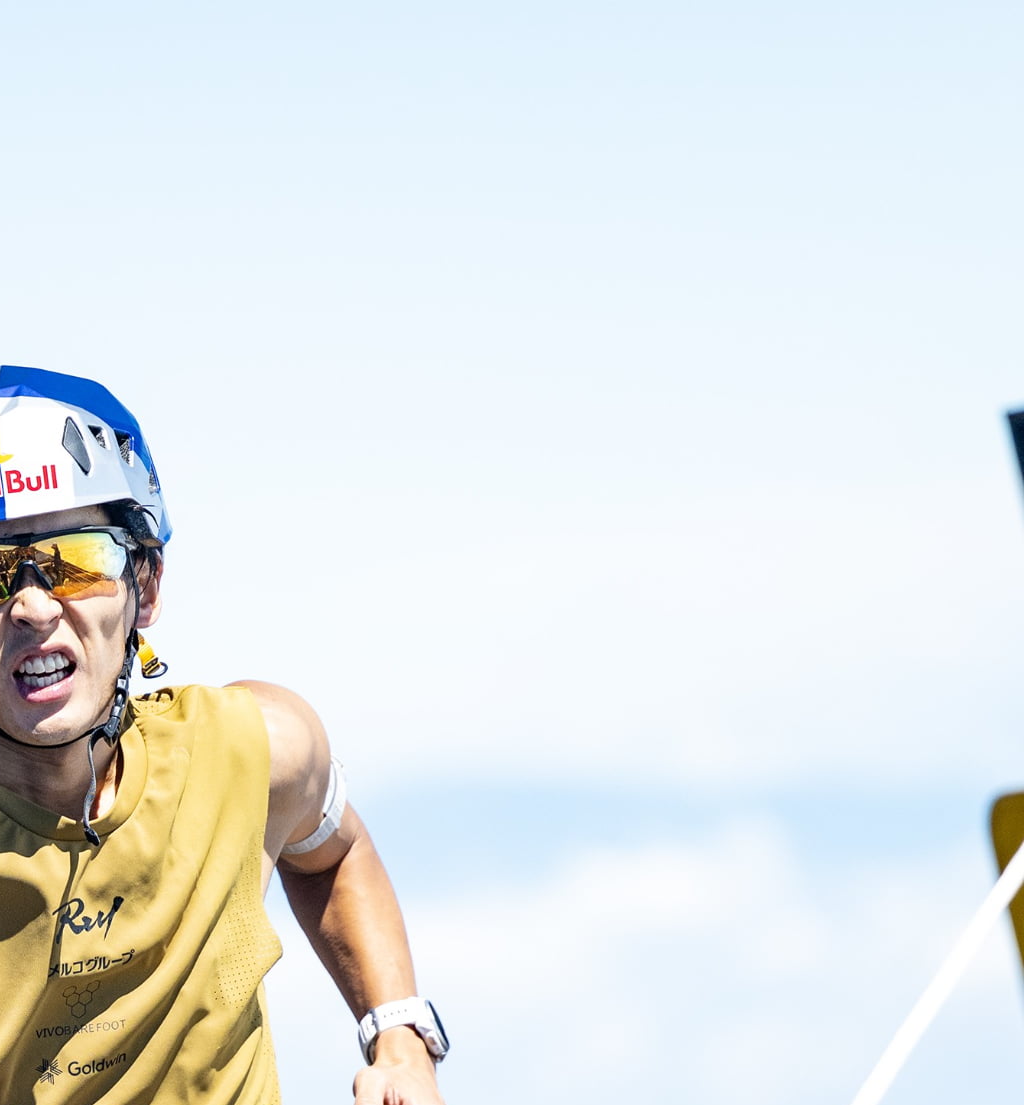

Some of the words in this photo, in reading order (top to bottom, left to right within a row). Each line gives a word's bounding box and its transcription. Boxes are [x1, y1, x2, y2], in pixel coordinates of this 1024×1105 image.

[6, 464, 58, 494] Bull
[48, 949, 135, 978] メルコグループ
[68, 1052, 126, 1077] Goldwin
